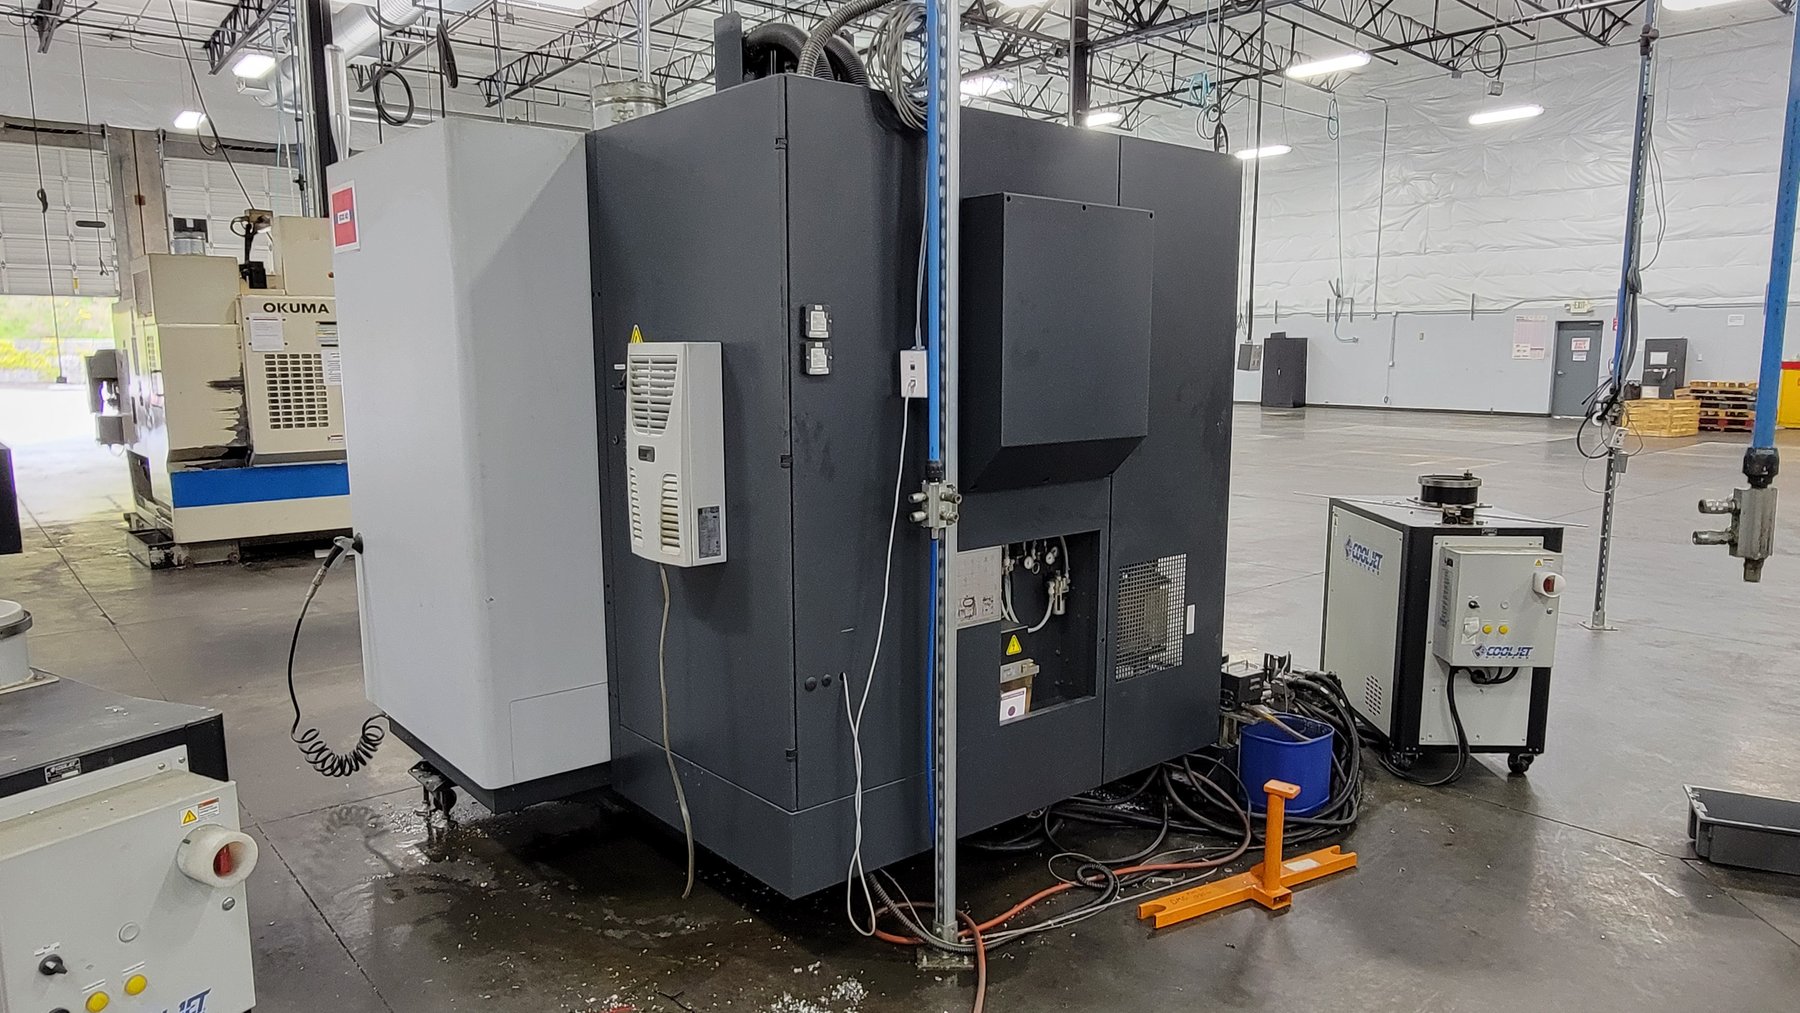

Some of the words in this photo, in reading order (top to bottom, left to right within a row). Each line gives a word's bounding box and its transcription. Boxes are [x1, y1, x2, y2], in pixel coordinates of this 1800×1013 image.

[263, 302, 330, 314] OKUMA
[1573, 301, 1586, 309] EXIT
[1352, 543, 1383, 571] COOLJET
[1486, 646, 1534, 657] COOLJET
